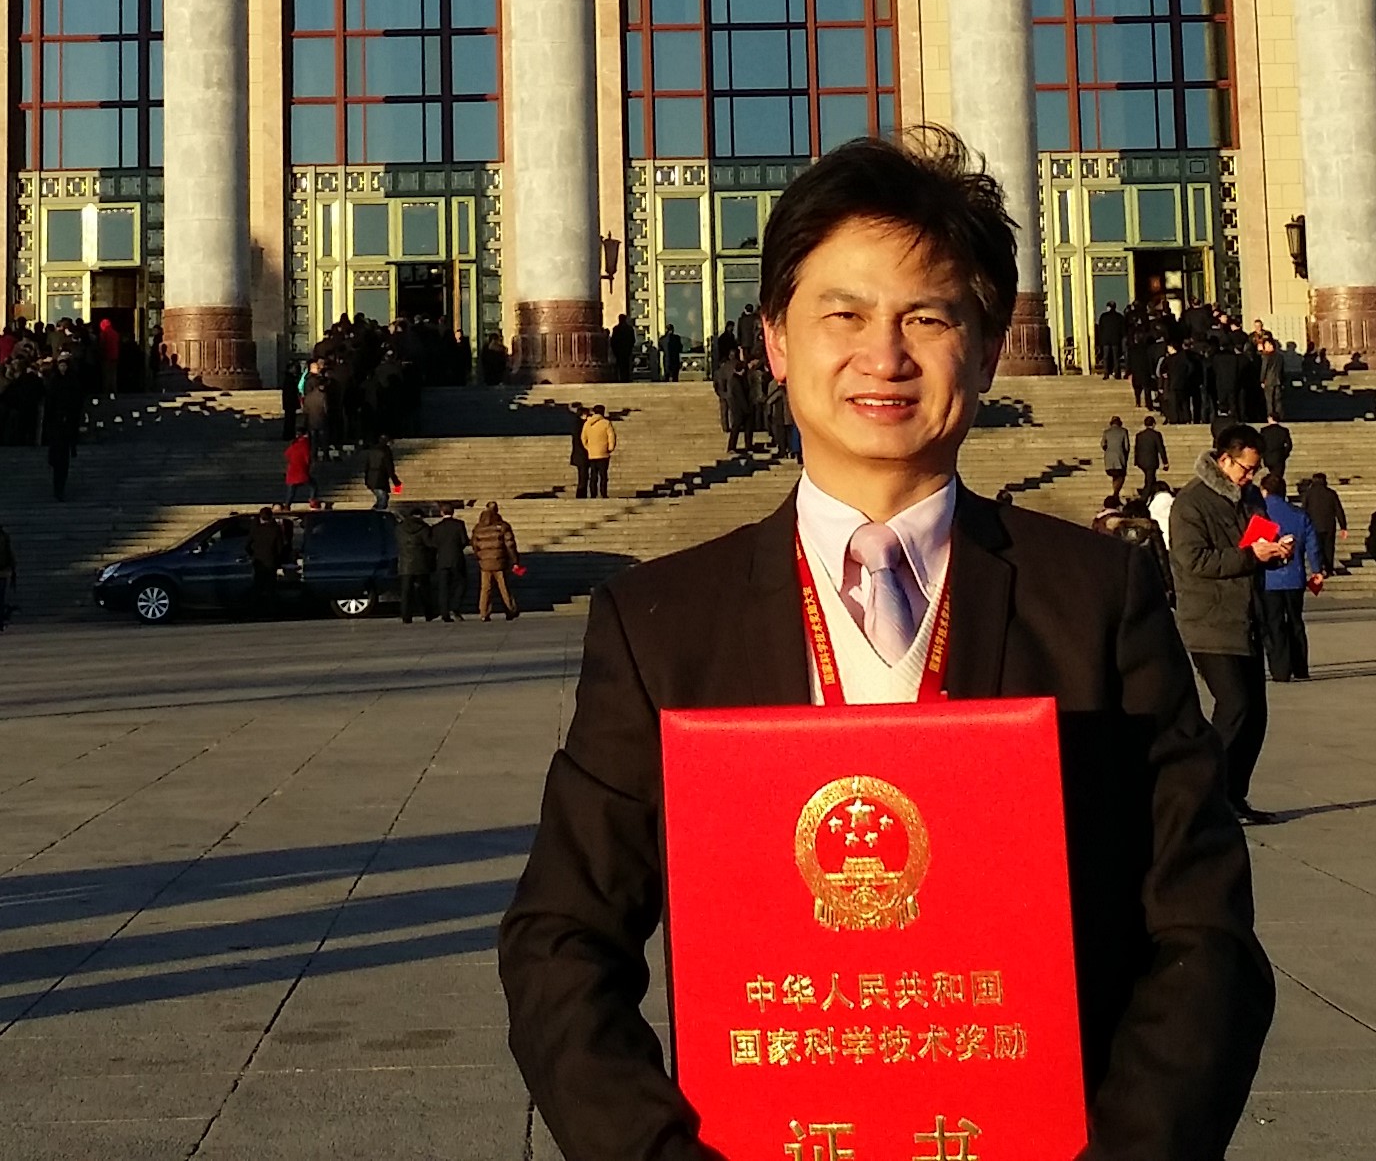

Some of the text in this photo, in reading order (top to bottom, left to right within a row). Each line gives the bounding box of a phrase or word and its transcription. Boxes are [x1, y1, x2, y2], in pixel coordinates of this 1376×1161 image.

[745, 971, 1004, 1013] 中华人民共和国
[729, 1022, 1028, 1067] 国家科学技术奖励
